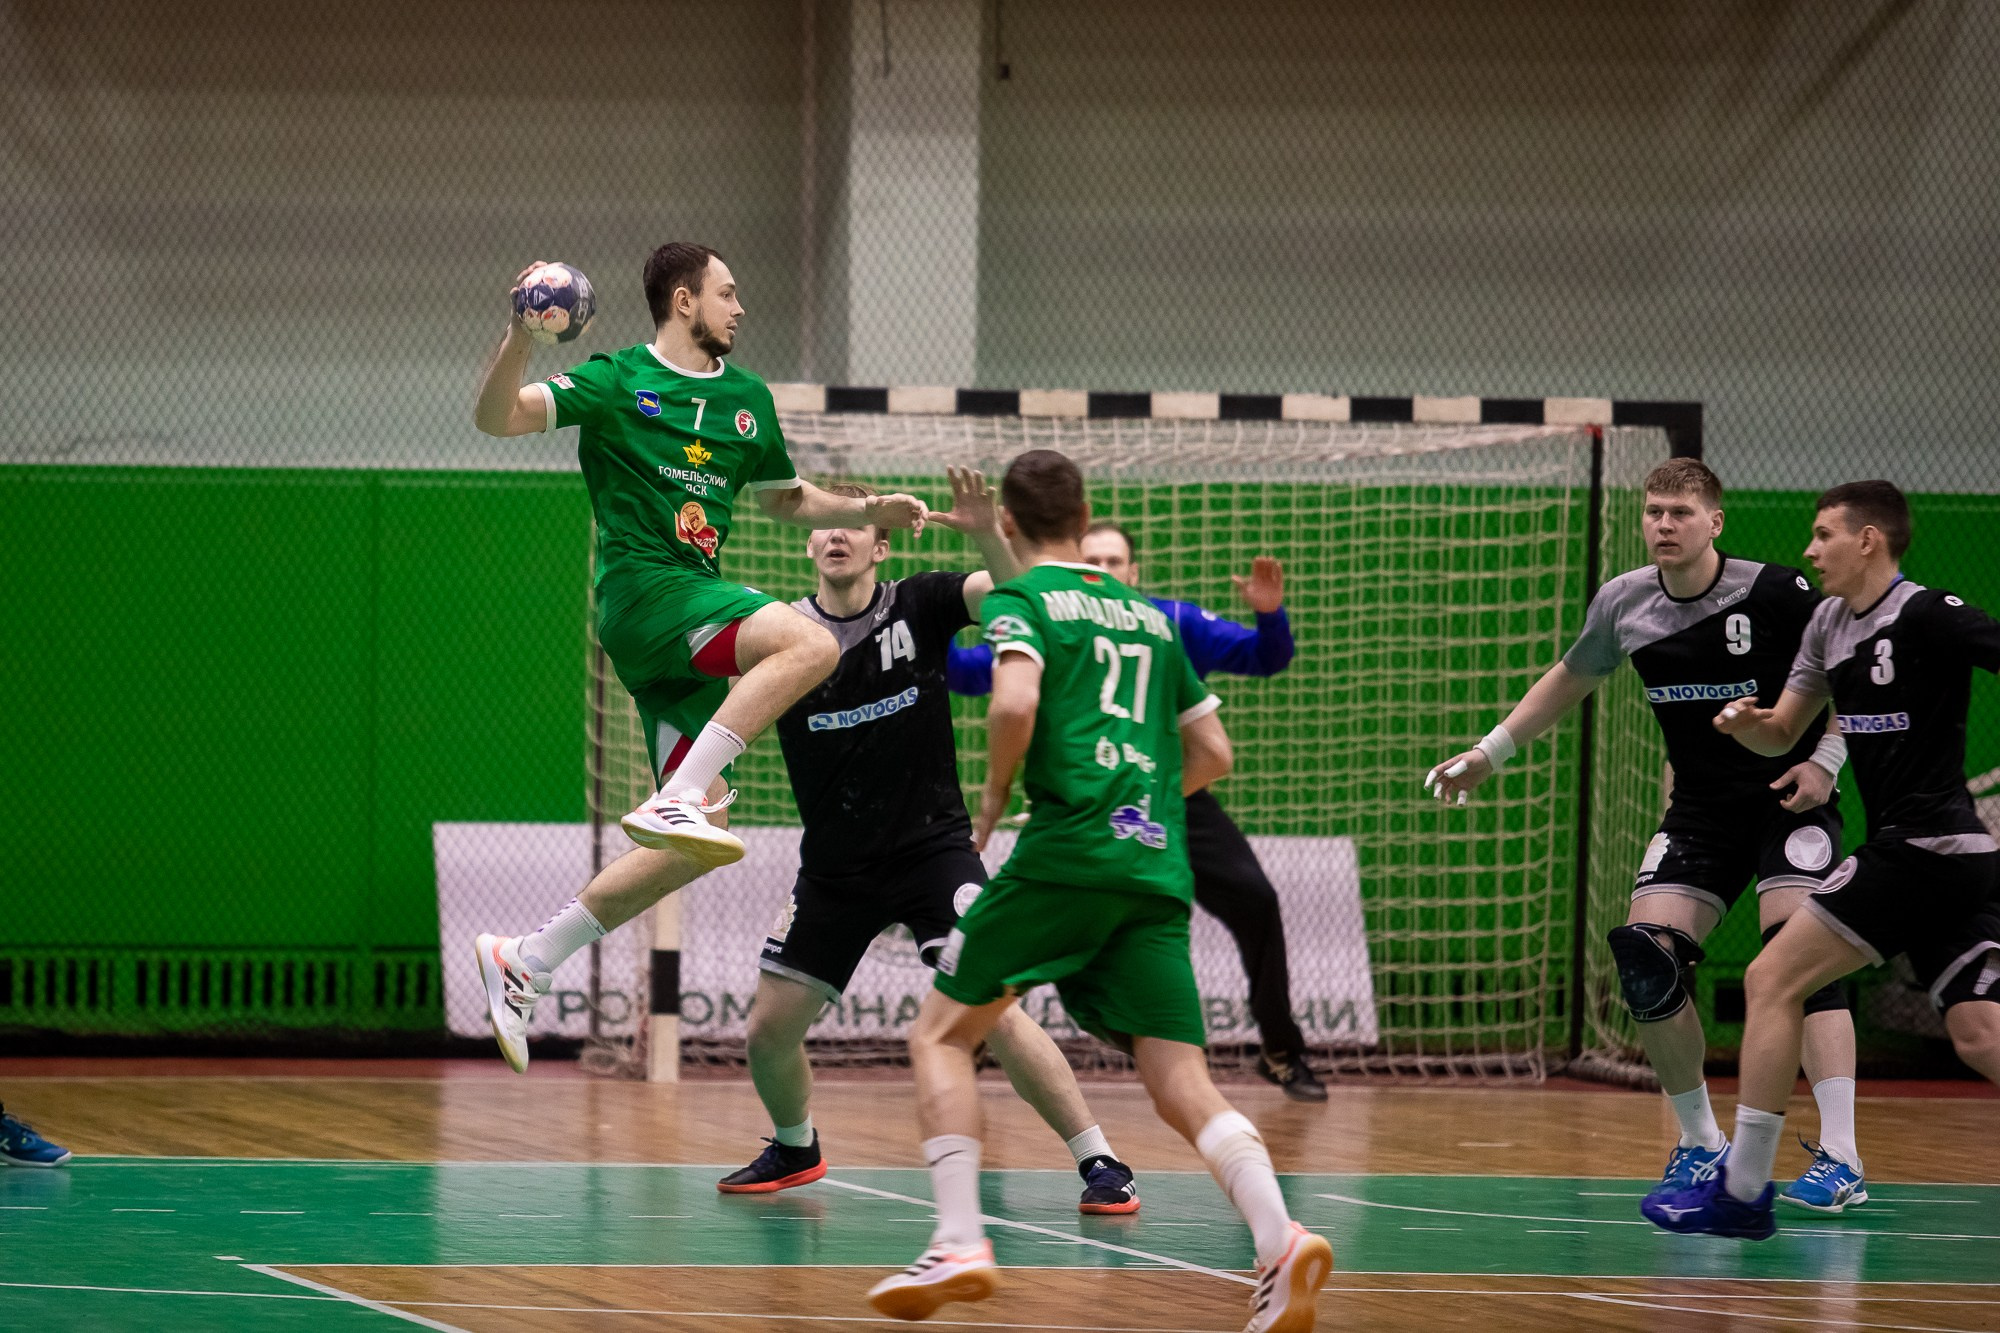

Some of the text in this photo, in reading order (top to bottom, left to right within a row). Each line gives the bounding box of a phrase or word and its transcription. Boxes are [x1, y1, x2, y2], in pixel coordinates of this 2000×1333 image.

[691, 397, 707, 431] 7
[658, 465, 728, 489] ГОМЕЛЬСКИЙ
[874, 619, 917, 672] 14
[1725, 613, 1752, 656] 9
[1094, 635, 1153, 724] 27
[1870, 638, 1896, 686] 3
[837, 688, 918, 727] NOVOGAS
[1668, 680, 1757, 701] NOVOGAS
